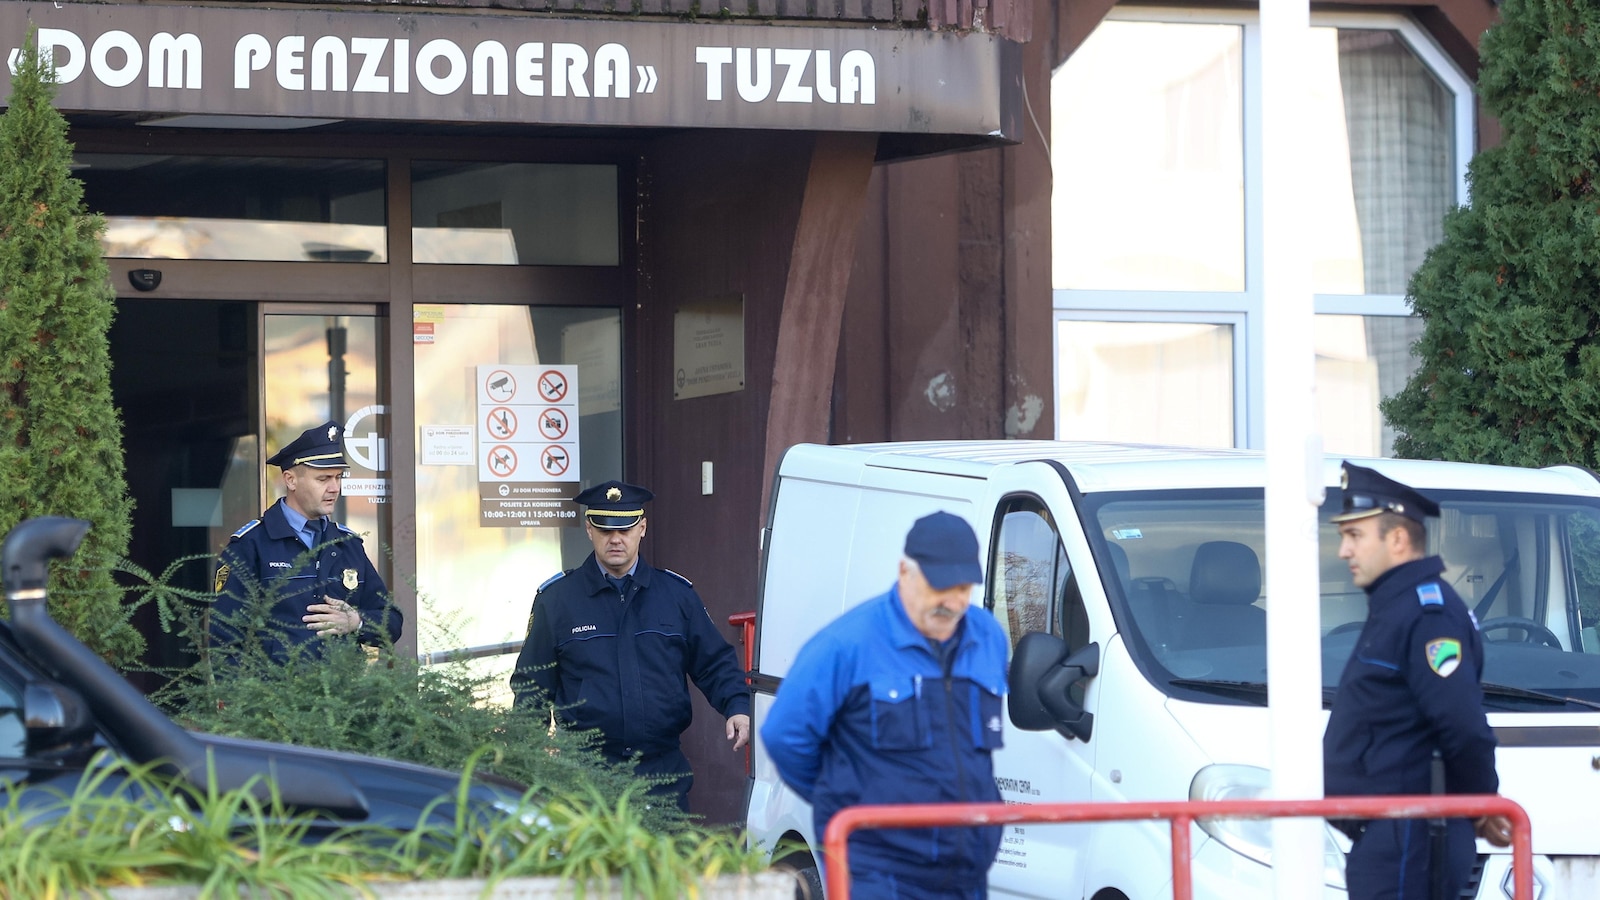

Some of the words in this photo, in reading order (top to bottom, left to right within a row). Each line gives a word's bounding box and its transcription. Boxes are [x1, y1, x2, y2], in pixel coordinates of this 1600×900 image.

[233, 33, 659, 99] PENZIONERA»
[695, 46, 876, 105] TUZLA
[571, 625, 597, 634] POLICIJA
